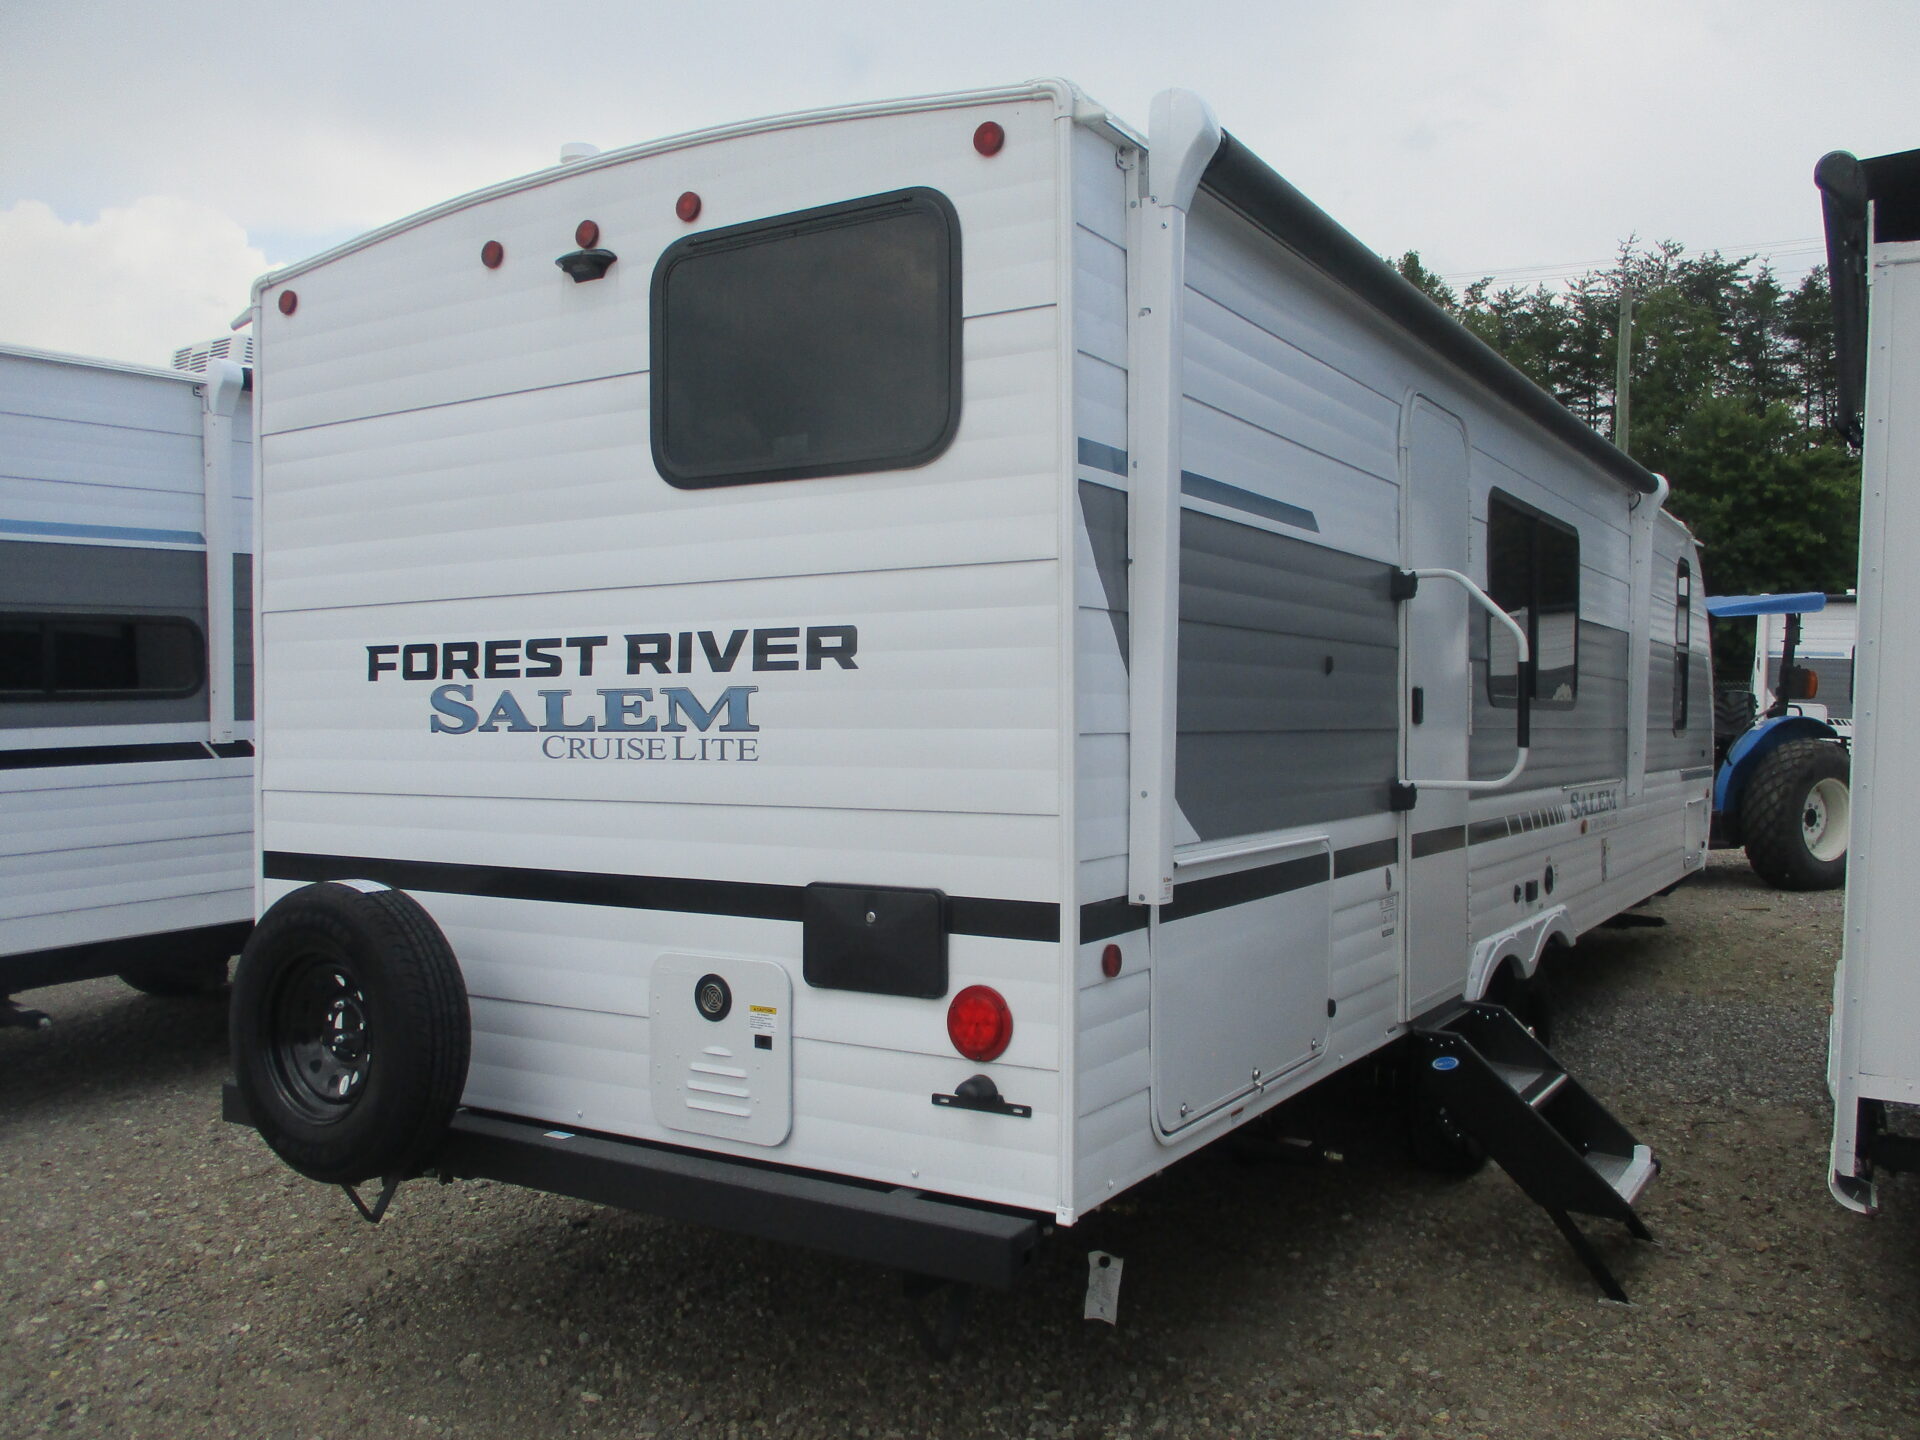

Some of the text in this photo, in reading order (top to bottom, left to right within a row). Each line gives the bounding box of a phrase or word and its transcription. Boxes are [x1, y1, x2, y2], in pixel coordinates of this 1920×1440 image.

[366, 625, 859, 682] FOREST RIVER
[430, 684, 760, 734] SALEM
[1570, 789, 1617, 820] SALEM
